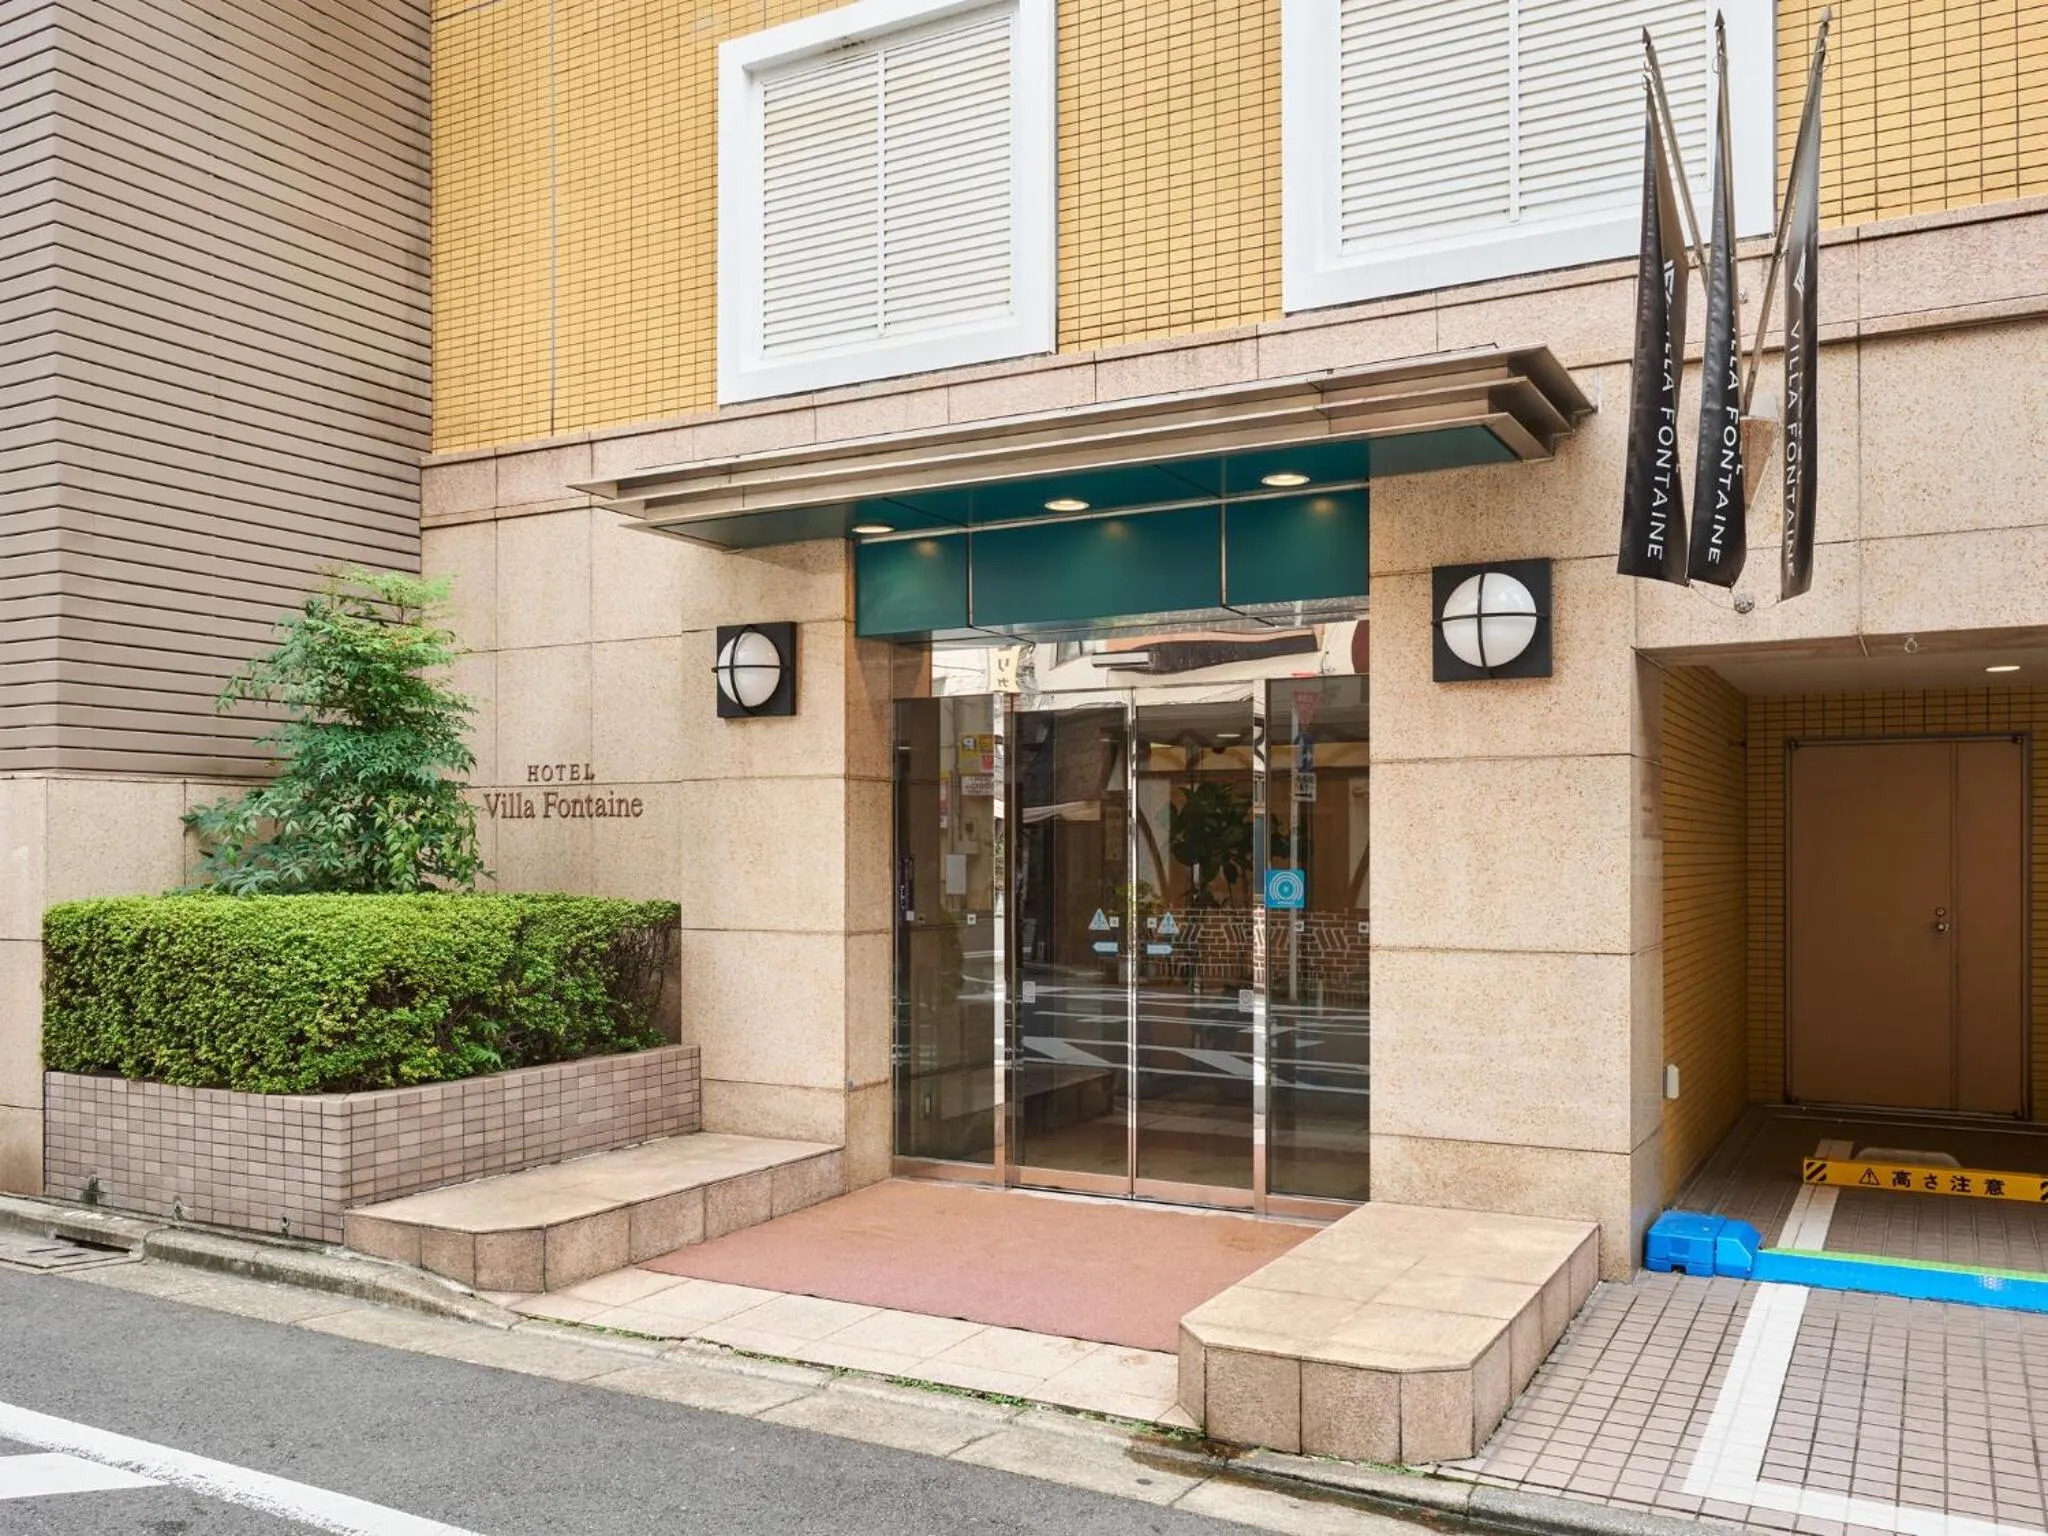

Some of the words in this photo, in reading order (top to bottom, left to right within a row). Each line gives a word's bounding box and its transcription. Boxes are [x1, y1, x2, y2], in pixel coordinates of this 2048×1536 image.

[1788, 319, 1800, 409] VILLA
[1647, 406, 1676, 561] FONTAINE
[1707, 405, 1738, 566] FONTAINE
[527, 763, 595, 782] HOTEL
[483, 791, 536, 819] Villa
[543, 790, 643, 819] Fontaine
[1892, 1170, 2005, 1195] 高さ注意
